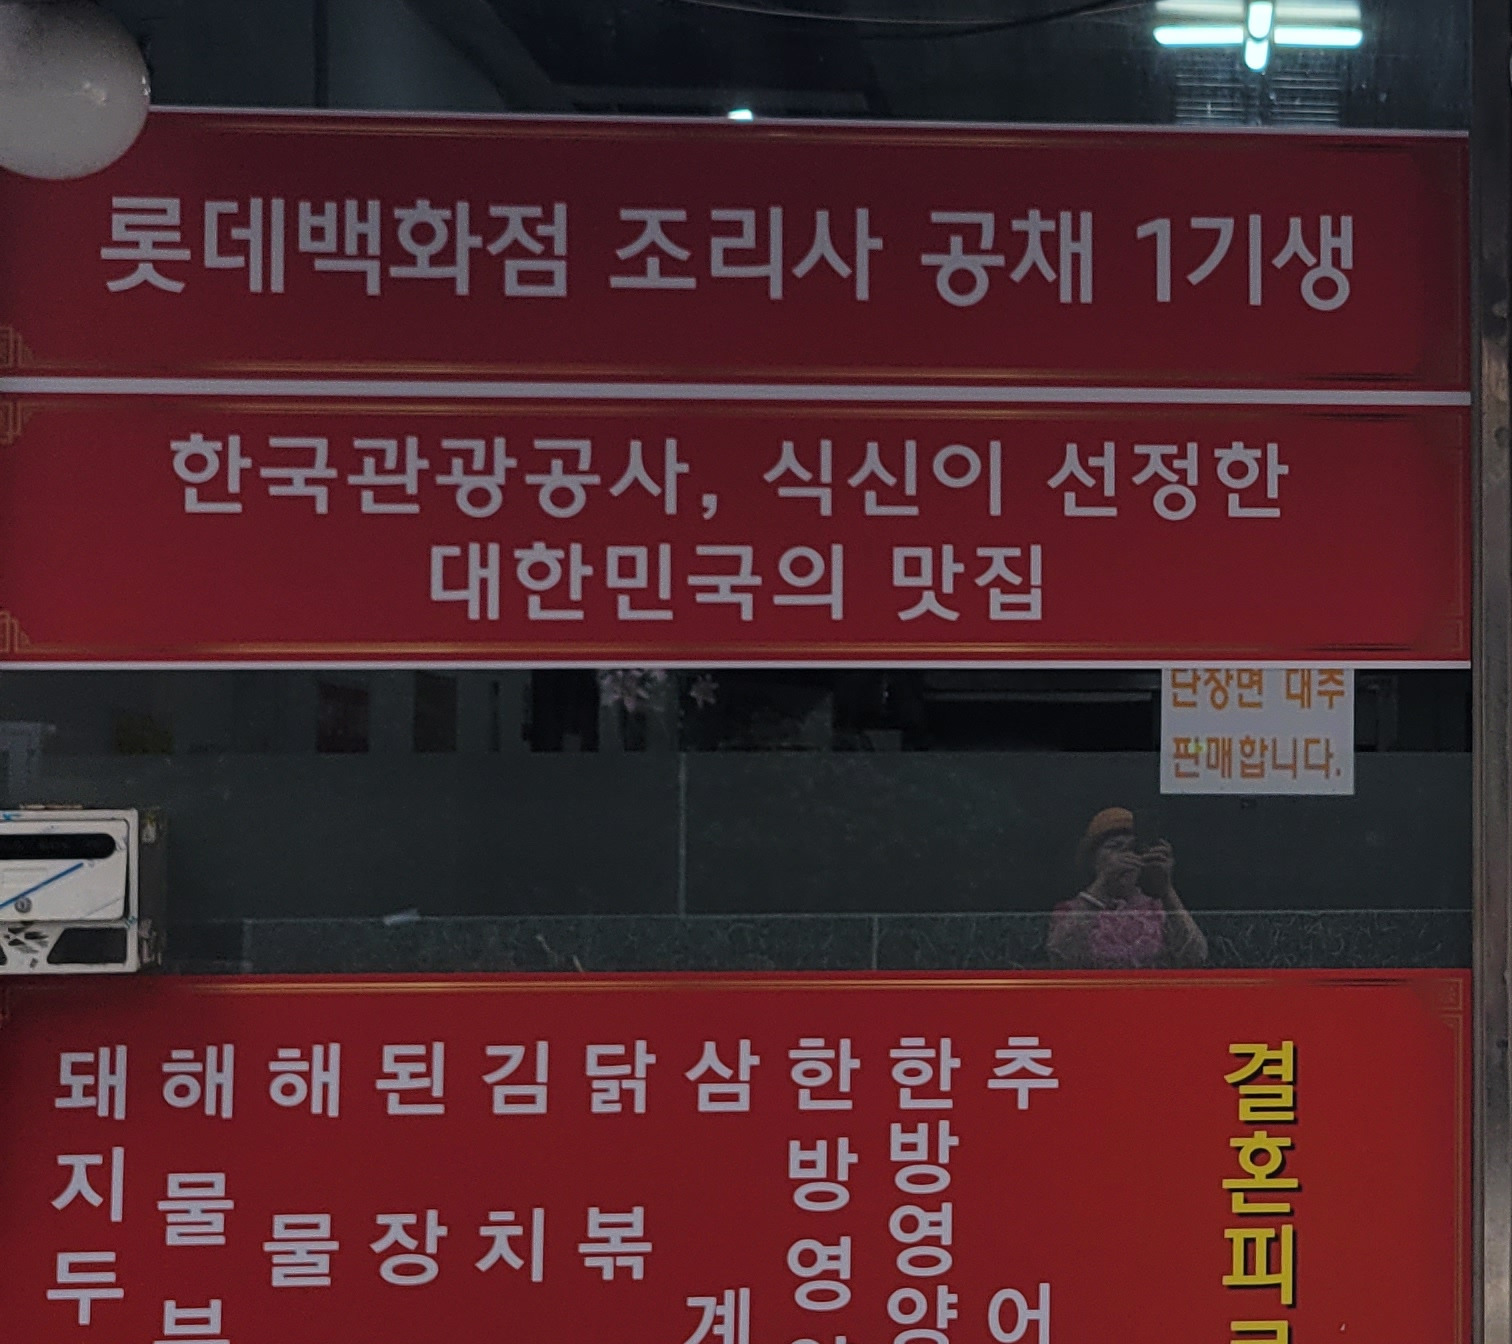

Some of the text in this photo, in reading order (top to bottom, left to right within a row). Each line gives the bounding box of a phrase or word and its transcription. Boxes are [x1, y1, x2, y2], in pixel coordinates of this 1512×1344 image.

[101, 197, 1354, 311] 롯데백화점 조리사 공채 1기생
[170, 432, 1289, 521] 한국관광공사, 식신이 선정한
[430, 541, 1043, 621] 대한민국의 맛집
[1172, 735, 1341, 780] 판매합니다.
